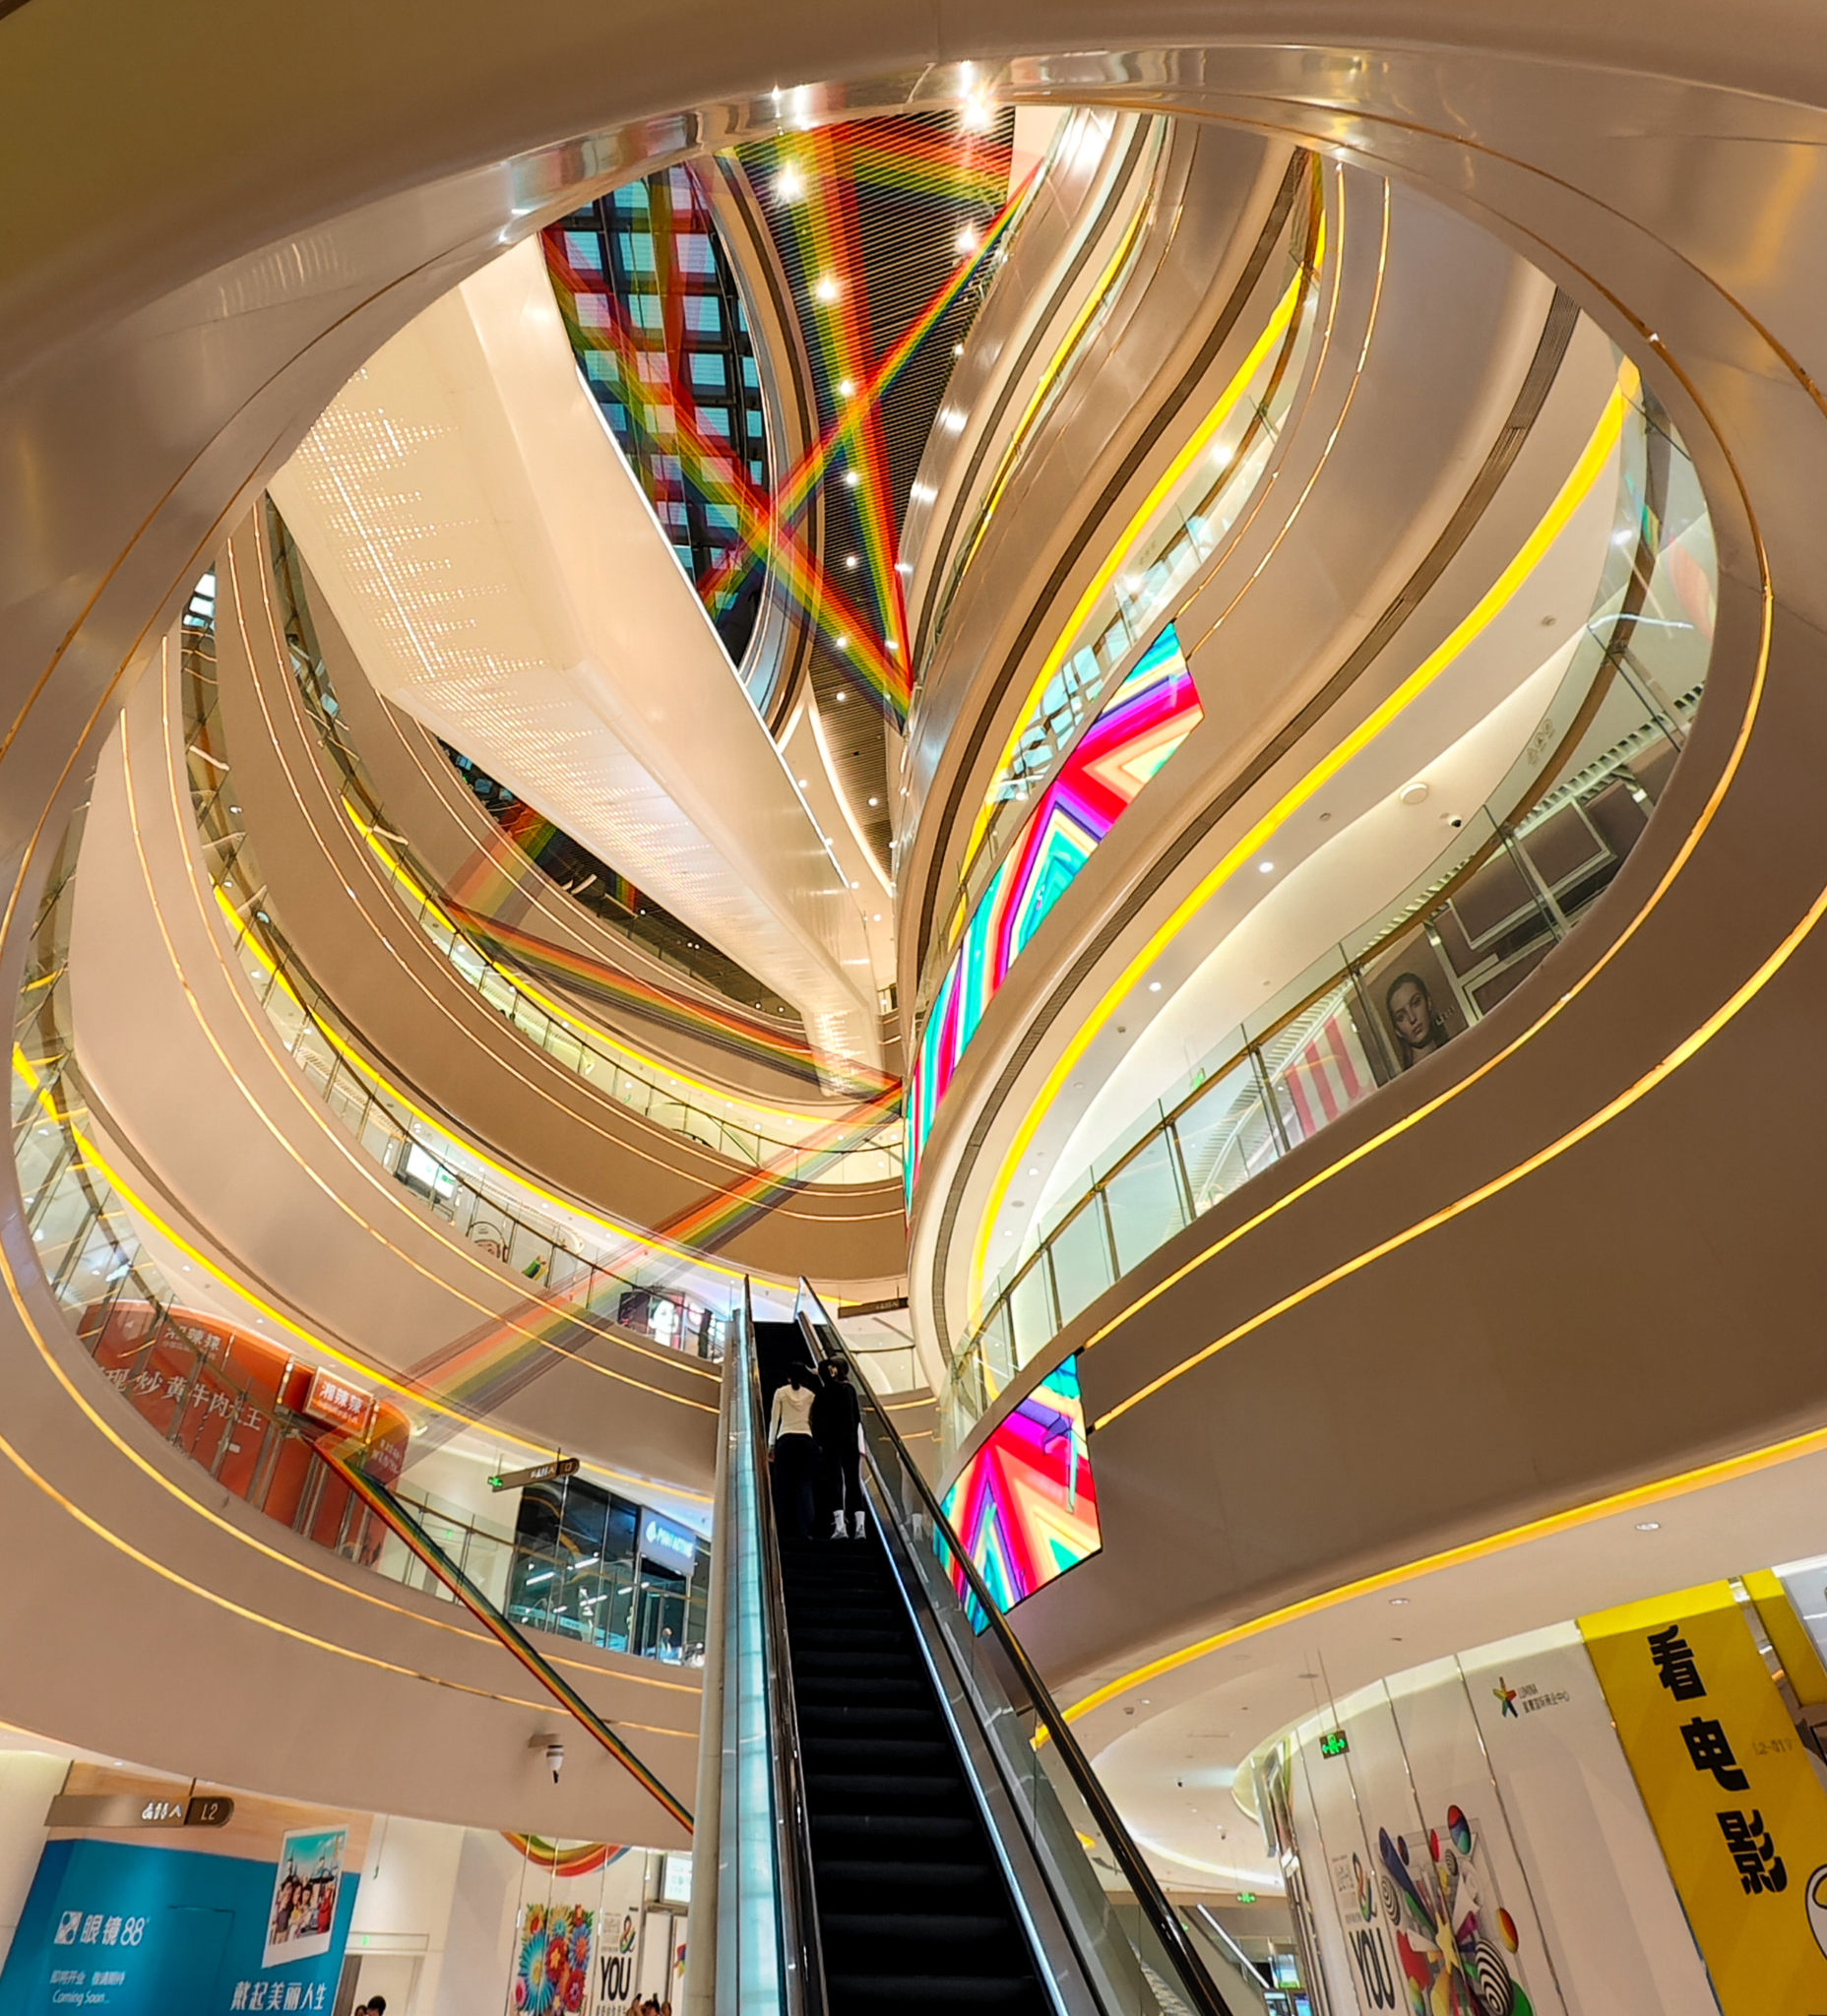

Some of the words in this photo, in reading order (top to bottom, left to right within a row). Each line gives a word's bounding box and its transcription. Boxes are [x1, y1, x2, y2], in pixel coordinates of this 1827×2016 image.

[1646, 1624, 1789, 1896] 看电影
[200, 1802, 219, 1821] L2
[80, 1914, 147, 1946] 眼镜88
[599, 1955, 632, 2002] YOU
[1349, 1926, 1396, 2010] YOU
[52, 1989, 85, 2008] Coming
[230, 1980, 328, 2012] 戴起美丽人生
